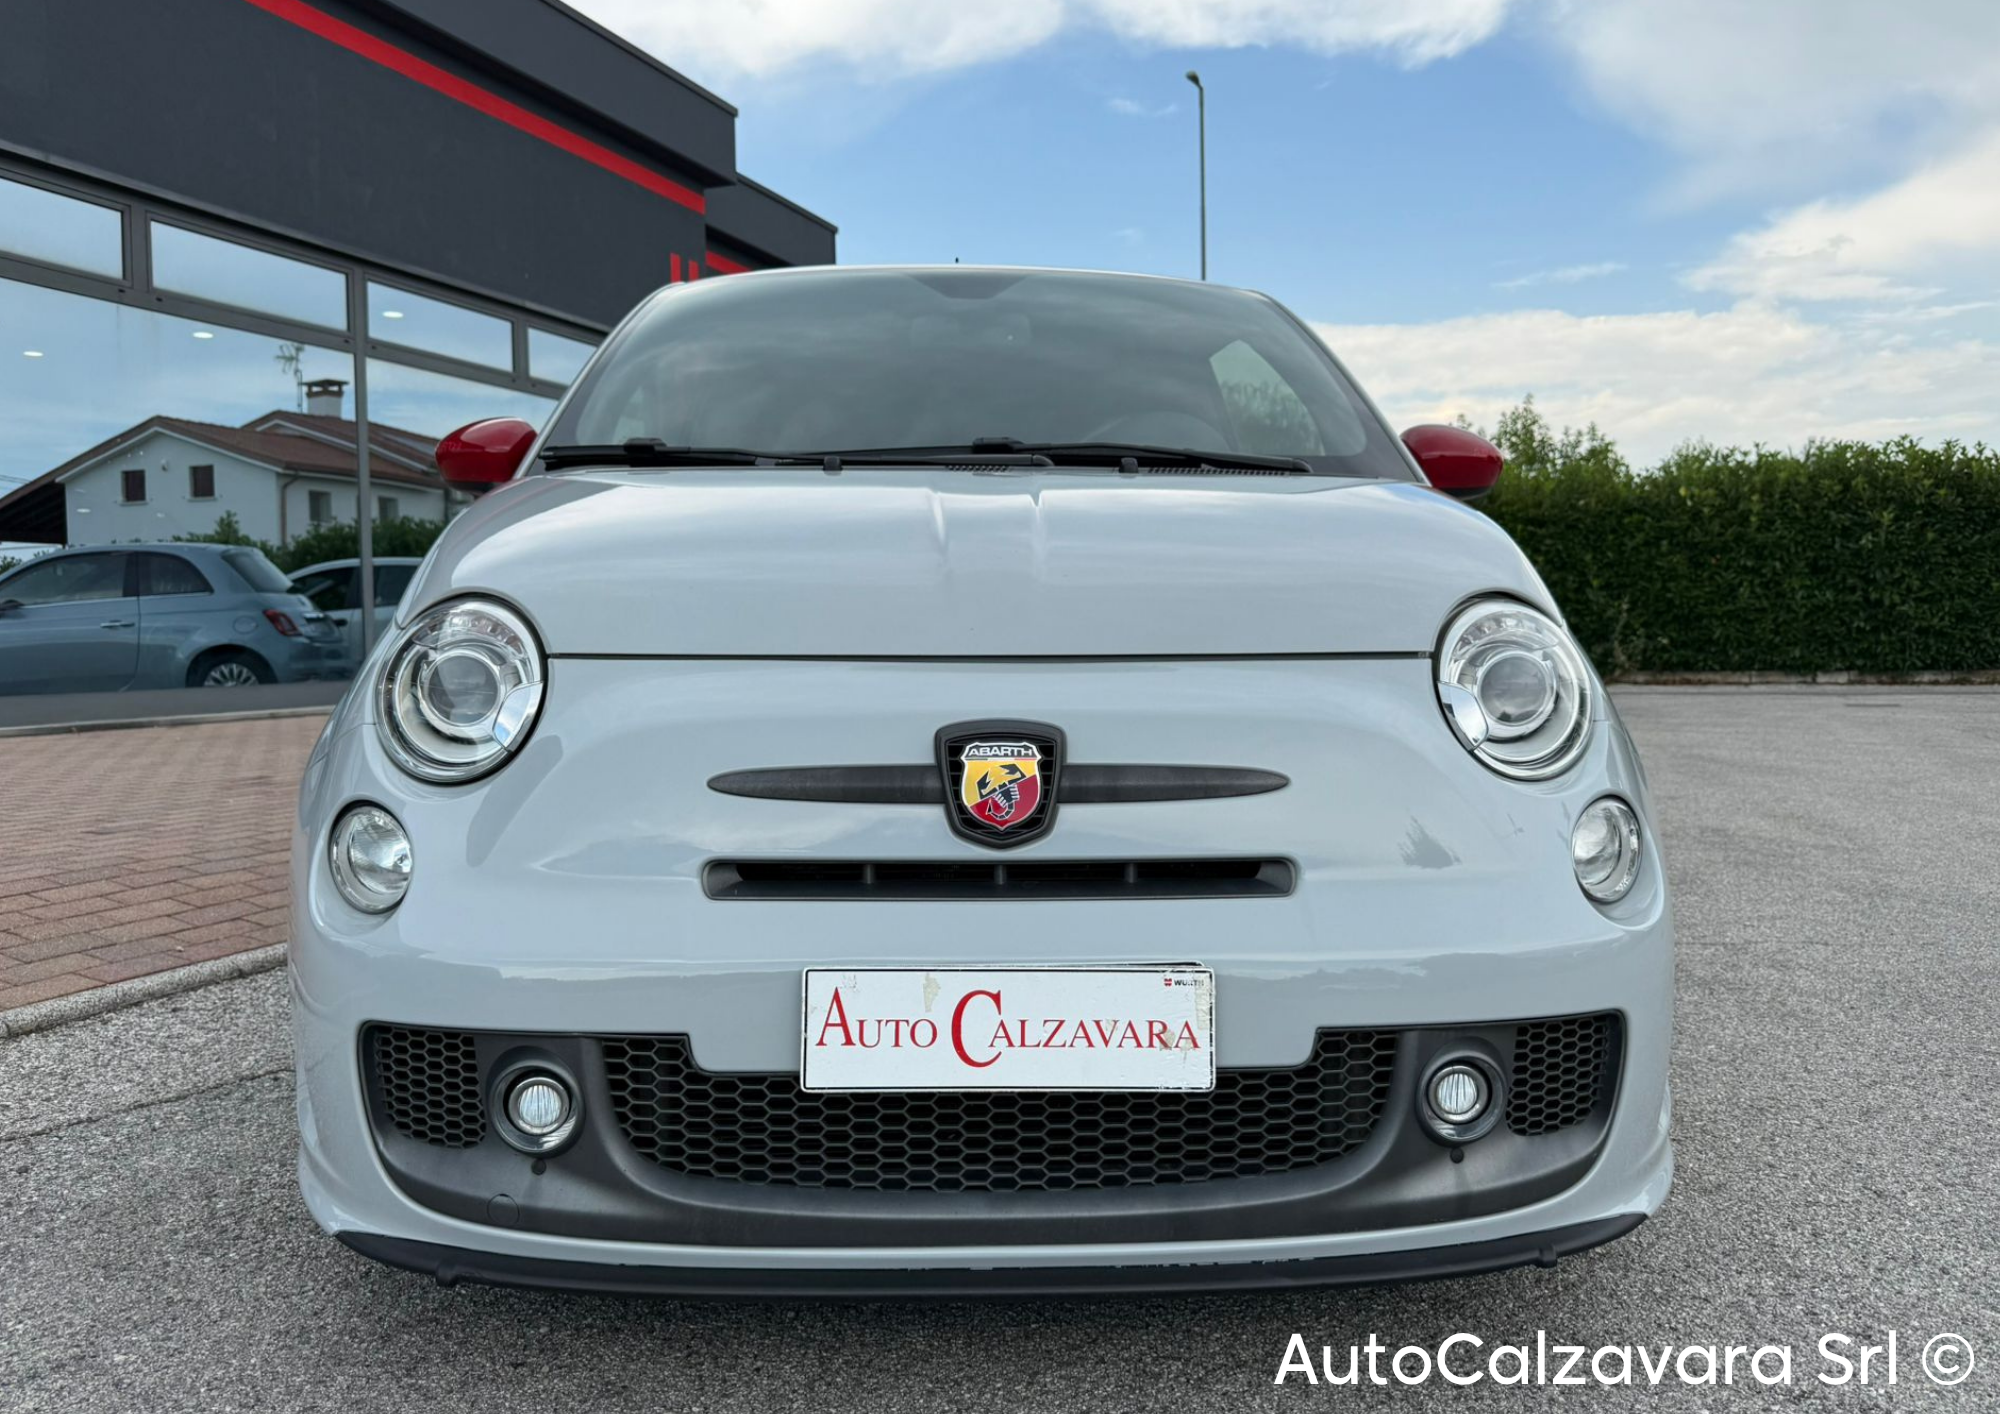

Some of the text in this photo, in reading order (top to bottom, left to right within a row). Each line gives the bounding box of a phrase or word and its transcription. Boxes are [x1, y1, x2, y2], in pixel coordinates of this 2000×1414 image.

[968, 746, 1033, 757] ABARTH
[815, 986, 1201, 1069] AUTO CALZAVARA
